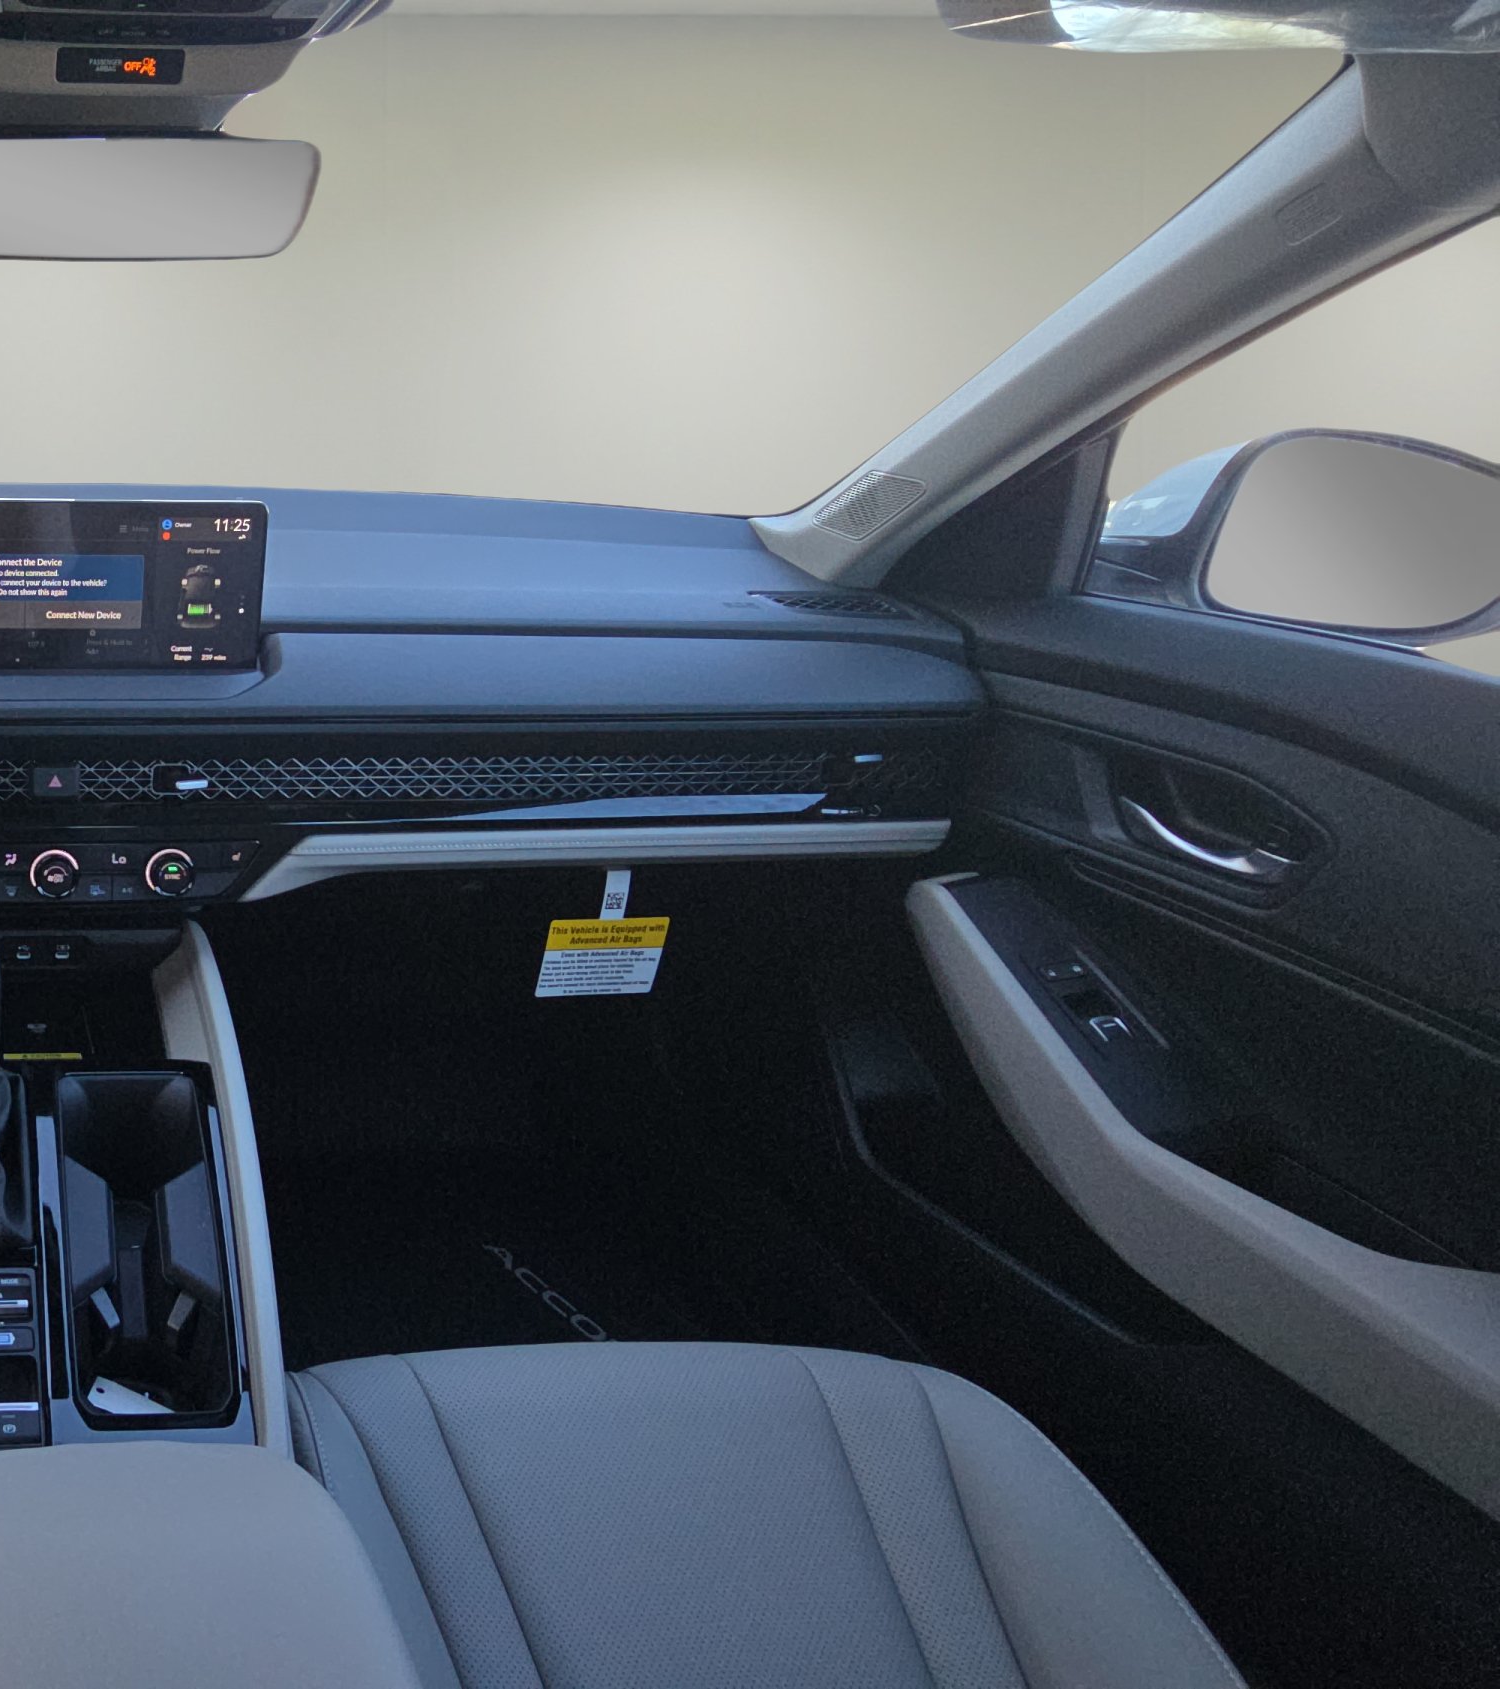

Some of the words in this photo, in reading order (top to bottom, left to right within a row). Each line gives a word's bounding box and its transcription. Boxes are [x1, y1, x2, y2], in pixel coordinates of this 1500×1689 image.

[124, 61, 143, 72] OFF
[214, 518, 251, 532] 11:25
[23, 558, 35, 566] the
[37, 558, 63, 566] Device
[4, 569, 24, 577] device
[26, 580, 41, 588] your
[8, 588, 19, 596] not
[19, 588, 37, 596] show
[38, 588, 50, 596] this
[51, 588, 68, 597] again
[46, 611, 77, 619] Connect
[77, 611, 95, 619] New
[96, 611, 122, 620] Device
[111, 853, 127, 865] Lo
[552, 926, 568, 935] This
[571, 926, 600, 934] Vehicle
[601, 925, 609, 934] is
[611, 925, 648, 936] Equipped
[648, 924, 665, 932] with
[570, 936, 607, 945] Advanced
[609, 935, 622, 943] Air
[623, 935, 642, 945] Bags
[482, 1244, 617, 1342] ACCO
